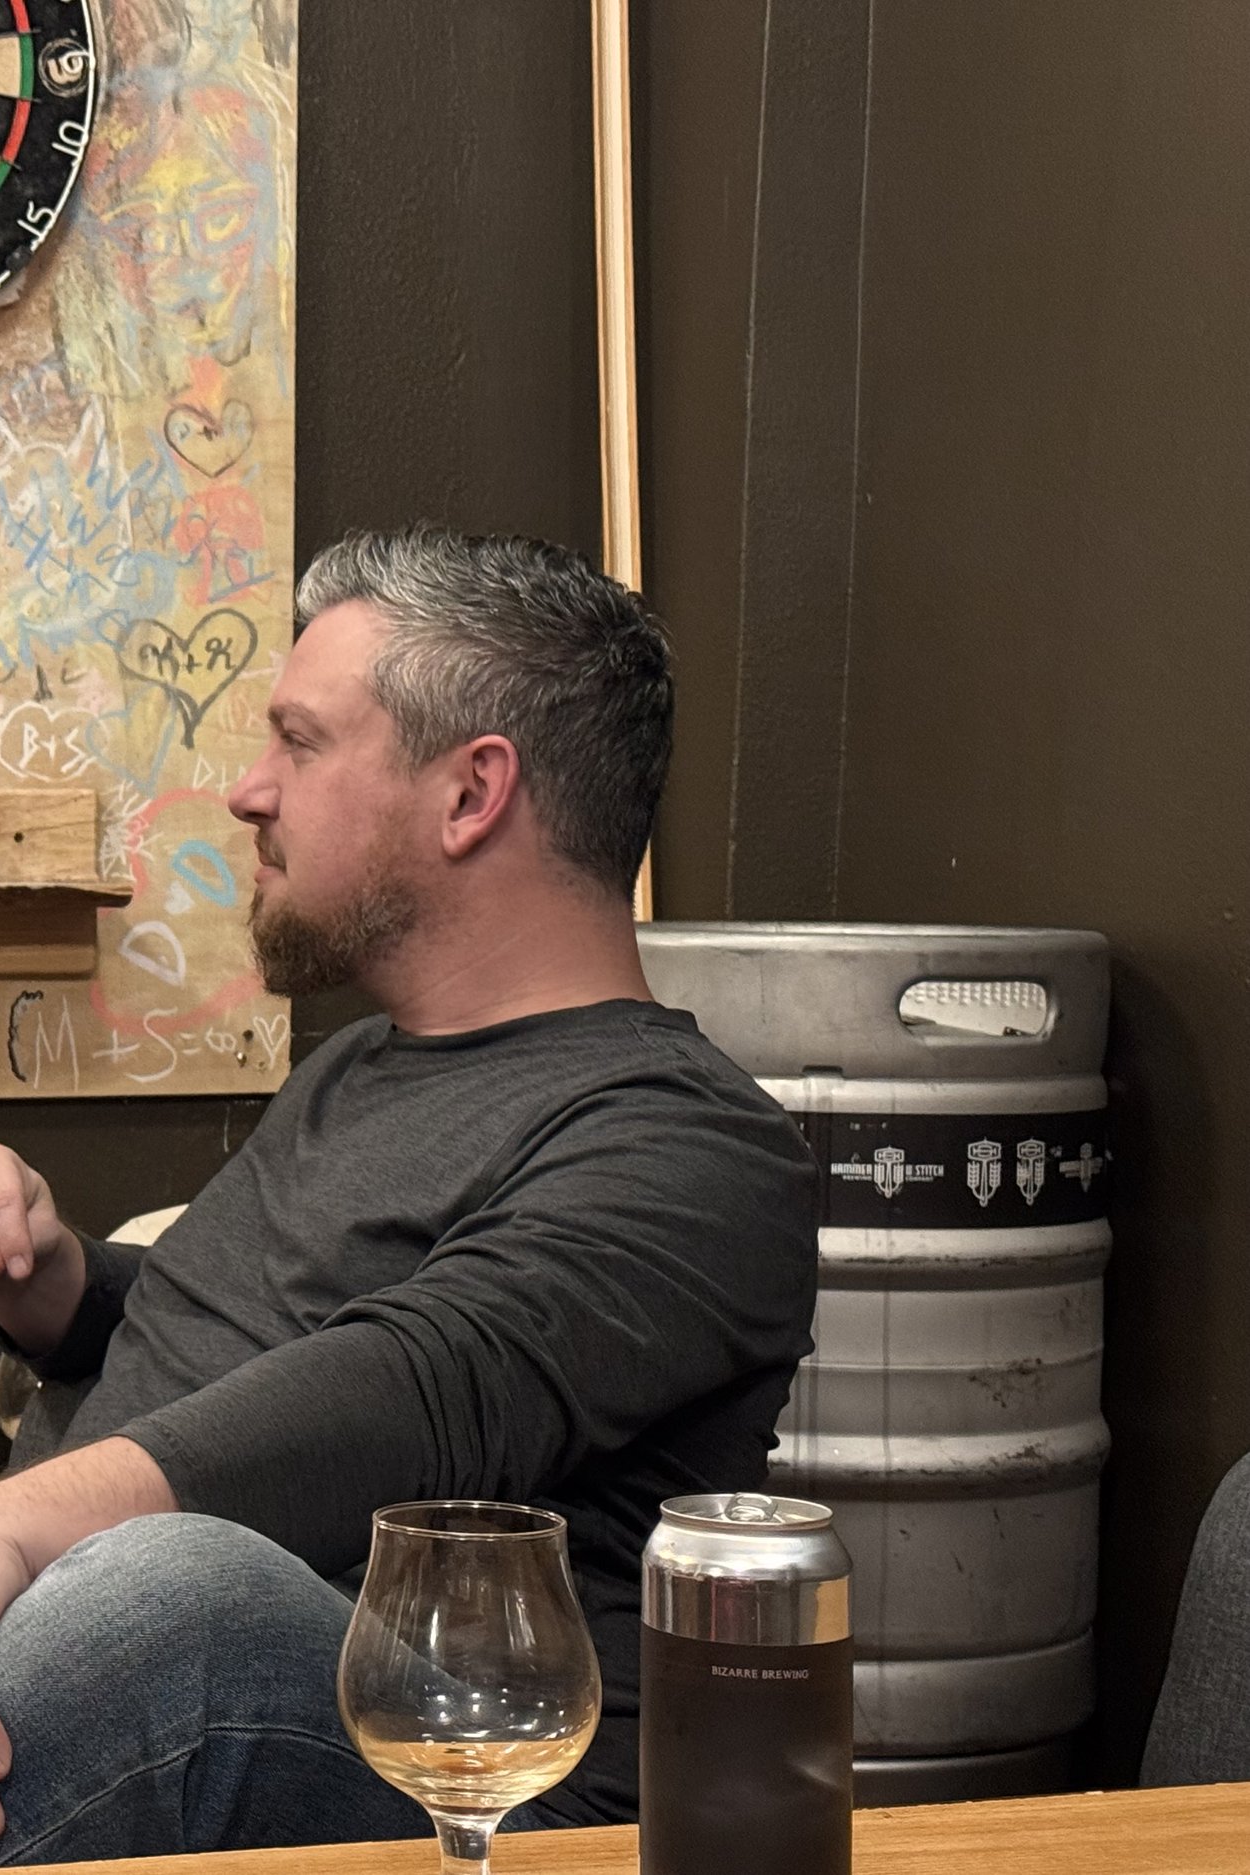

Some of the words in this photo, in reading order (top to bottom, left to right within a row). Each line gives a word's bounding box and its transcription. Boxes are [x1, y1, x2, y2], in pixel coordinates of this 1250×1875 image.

[51, 121, 88, 159] 10
[16, 201, 56, 246] 15
[830, 1162, 873, 1175] HAMMER
[916, 1164, 944, 1177] STITCH
[711, 1666, 757, 1678] BIZARRE
[762, 1669, 809, 1679] BREWING
